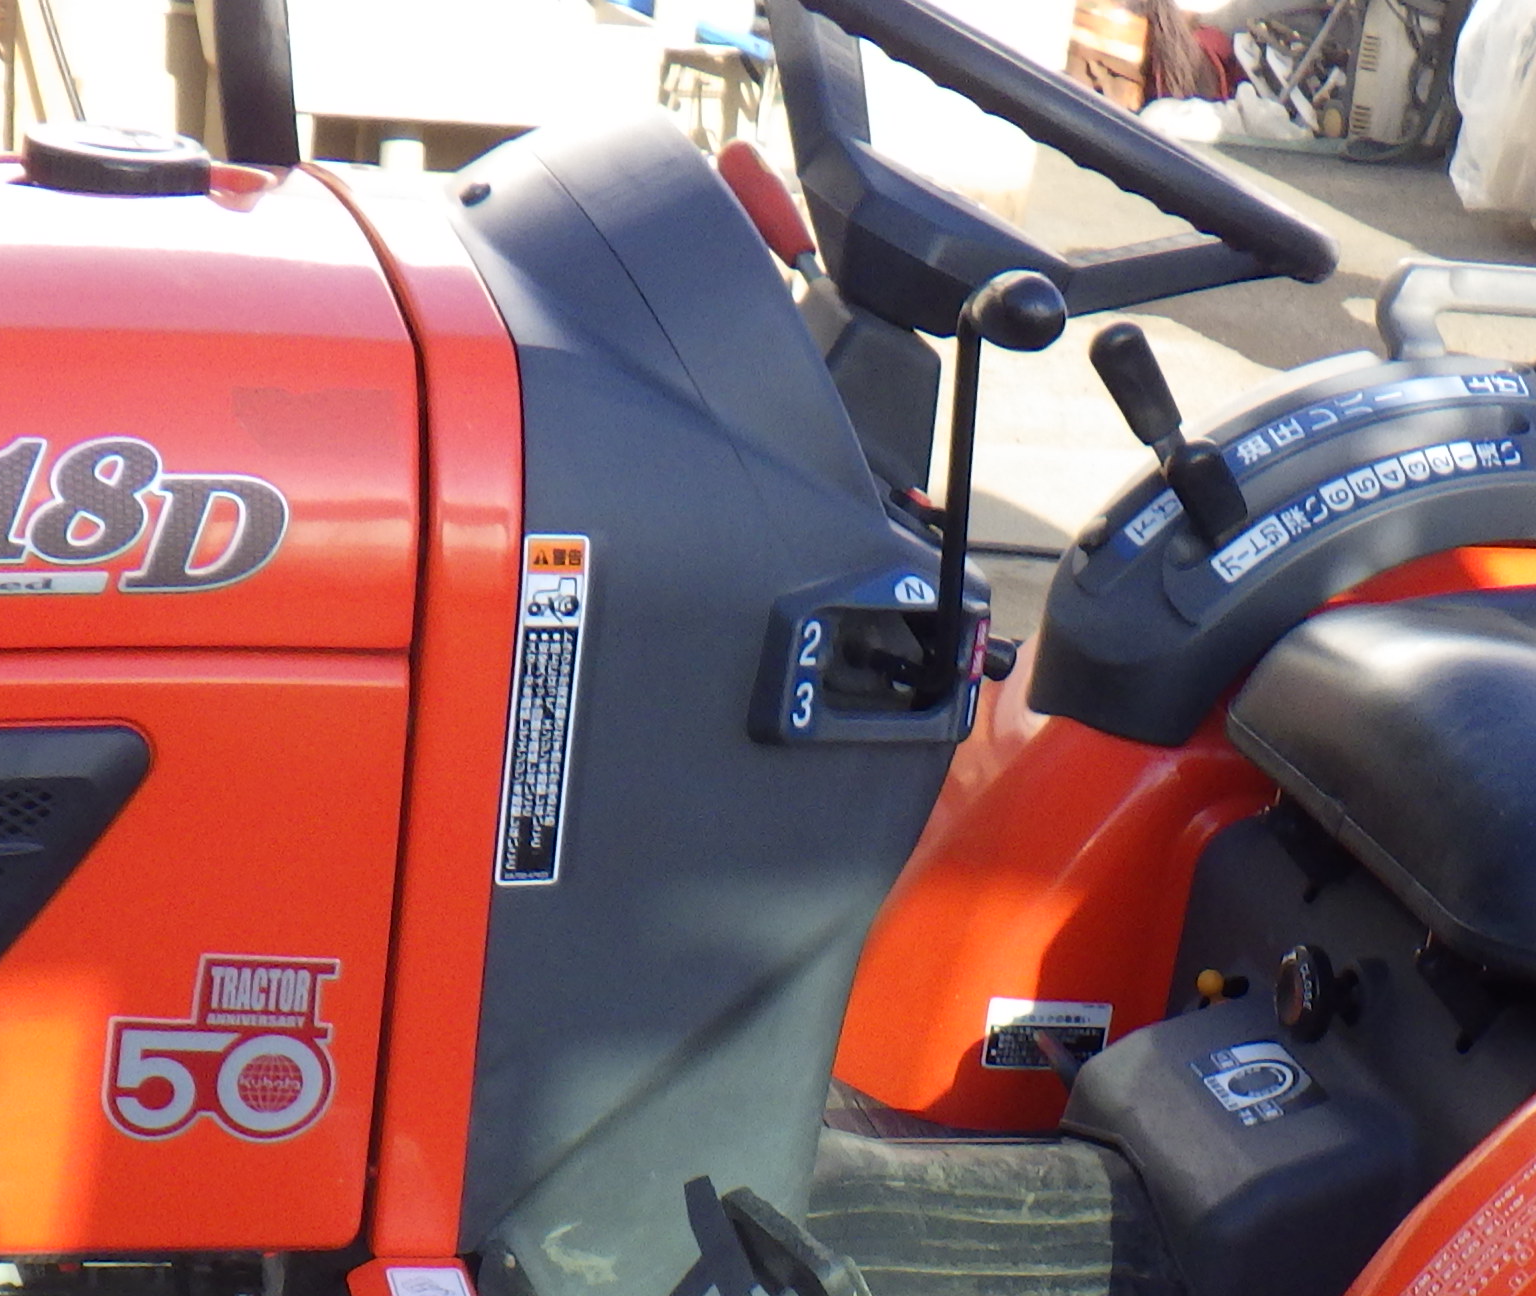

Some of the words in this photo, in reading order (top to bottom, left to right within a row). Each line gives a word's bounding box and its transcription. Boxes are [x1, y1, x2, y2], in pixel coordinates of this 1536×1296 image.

[1468, 375, 1520, 395] 上げ
[1236, 391, 1404, 465] 油圧レバー
[1131, 498, 1179, 540] 下げ
[1218, 523, 1285, 577] オート切
[1280, 495, 1328, 537] 深い
[1329, 488, 1350, 505] 6
[1357, 477, 1376, 494] 5
[1382, 470, 1402, 484] 4
[1408, 462, 1427, 475] 3
[1433, 455, 1451, 468] 2
[904, 582, 926, 600] N
[799, 620, 822, 666] 2
[792, 681, 814, 728] 3
[211, 965, 311, 1012] TRACTOR
[115, 1029, 324, 1132] 50
[239, 1075, 302, 1090] Kubota
